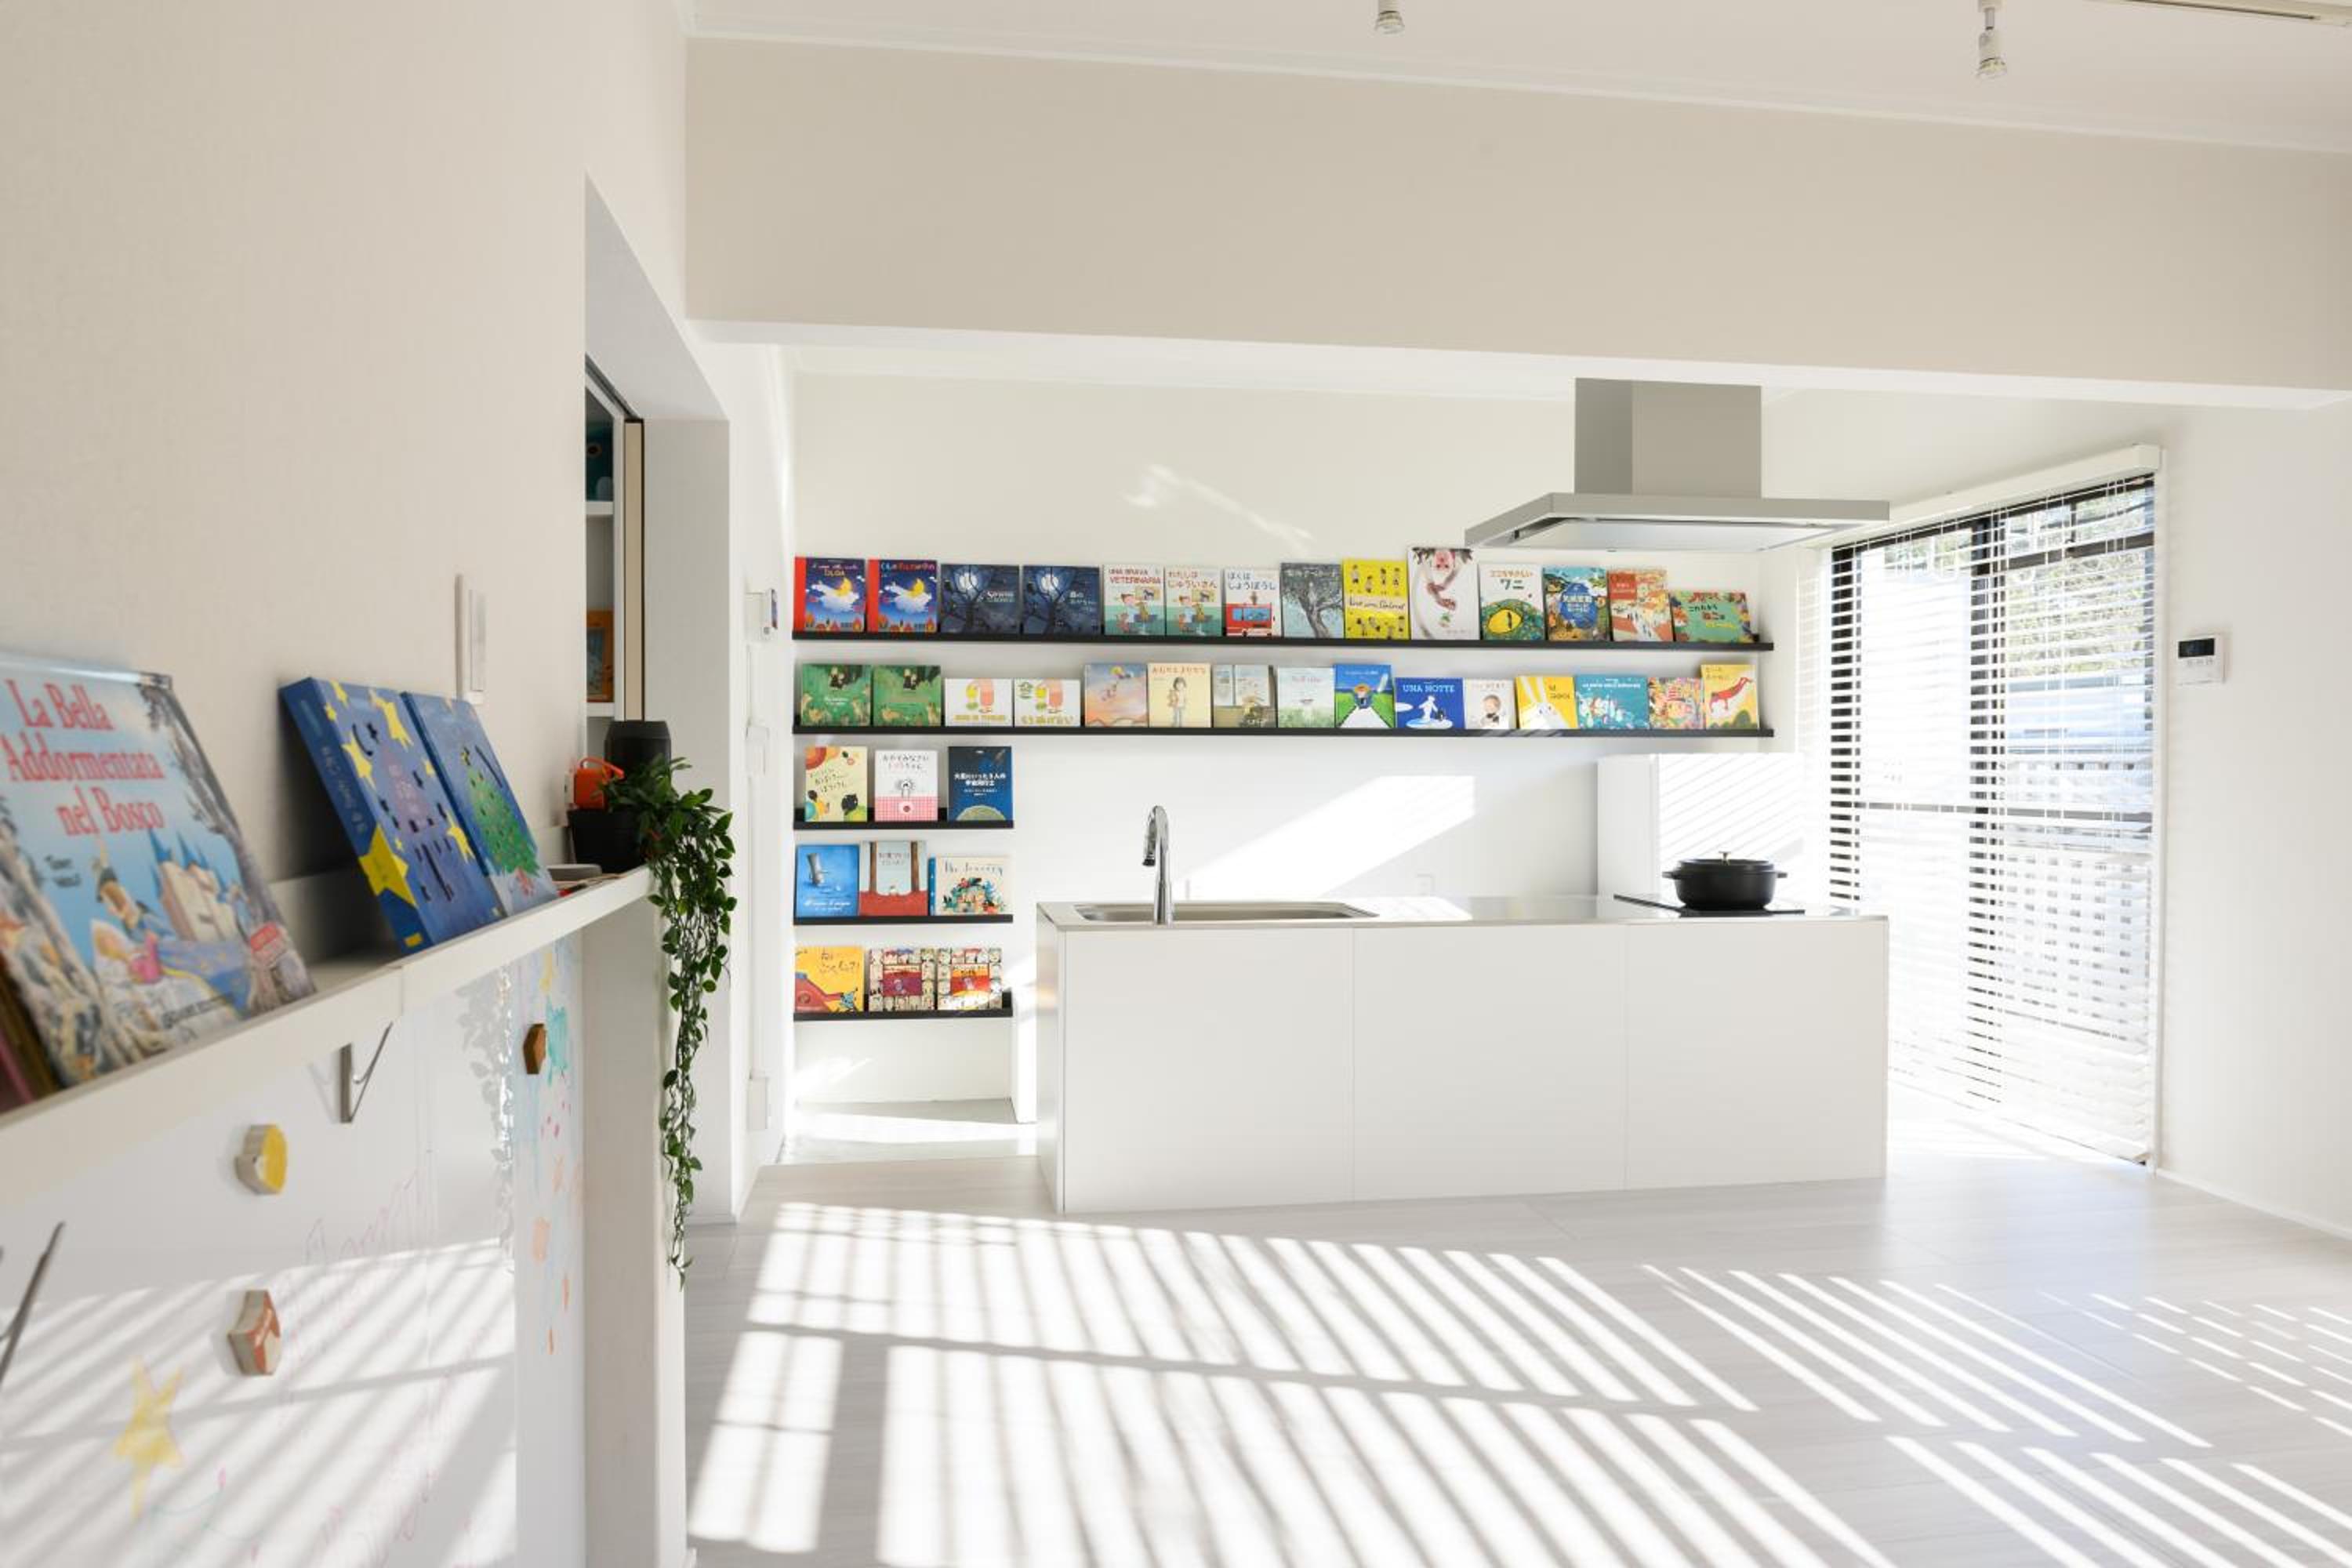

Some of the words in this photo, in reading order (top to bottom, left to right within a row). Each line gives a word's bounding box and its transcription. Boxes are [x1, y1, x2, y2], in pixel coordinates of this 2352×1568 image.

[6, 679, 52, 728] La
[45, 683, 116, 731] Bella
[1, 733, 165, 782] Addormentata
[56, 785, 97, 836] nel
[97, 786, 165, 834] Bosco
